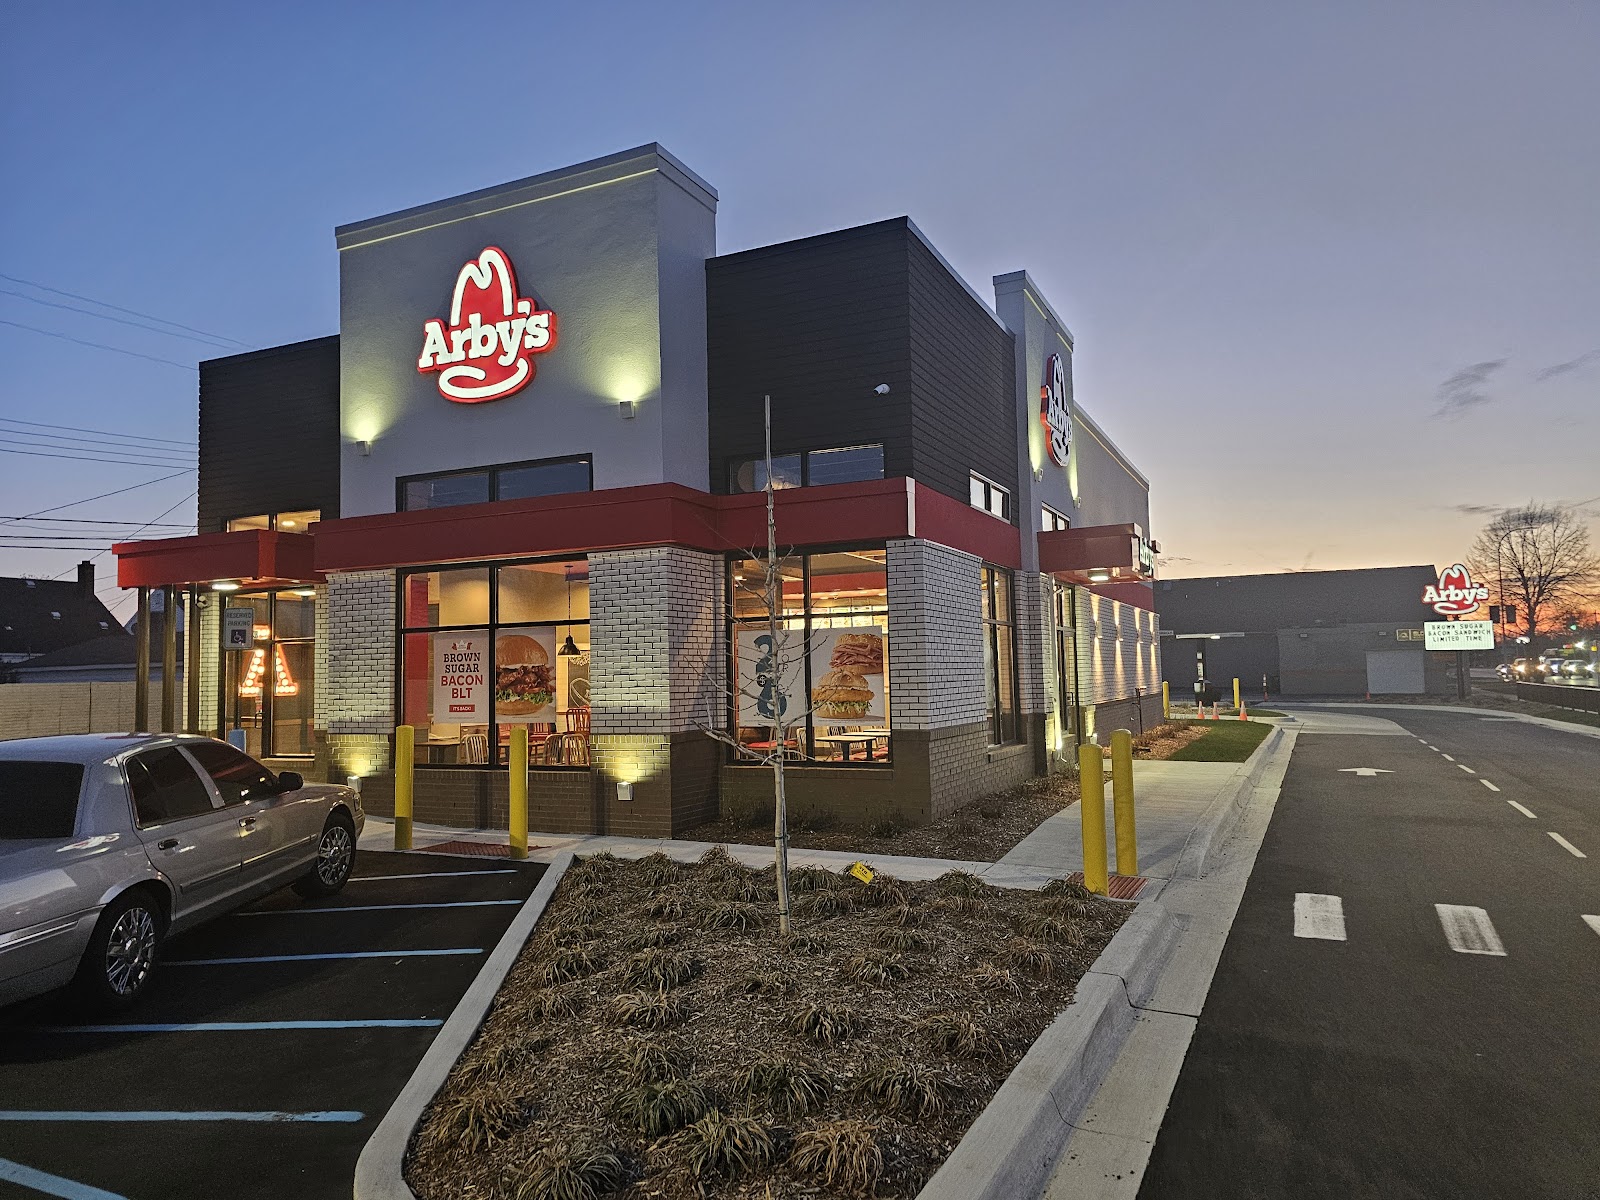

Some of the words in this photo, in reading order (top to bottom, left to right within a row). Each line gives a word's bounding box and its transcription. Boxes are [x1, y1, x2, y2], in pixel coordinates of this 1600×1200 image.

[418, 300, 550, 368] Arby's
[1423, 583, 1489, 605] Arby's
[1432, 635, 1460, 643] LIMITED
[443, 652, 481, 663] BROWN
[444, 663, 480, 674] SUGAR
[441, 674, 483, 687] BACON
[451, 687, 473, 699] BLT
